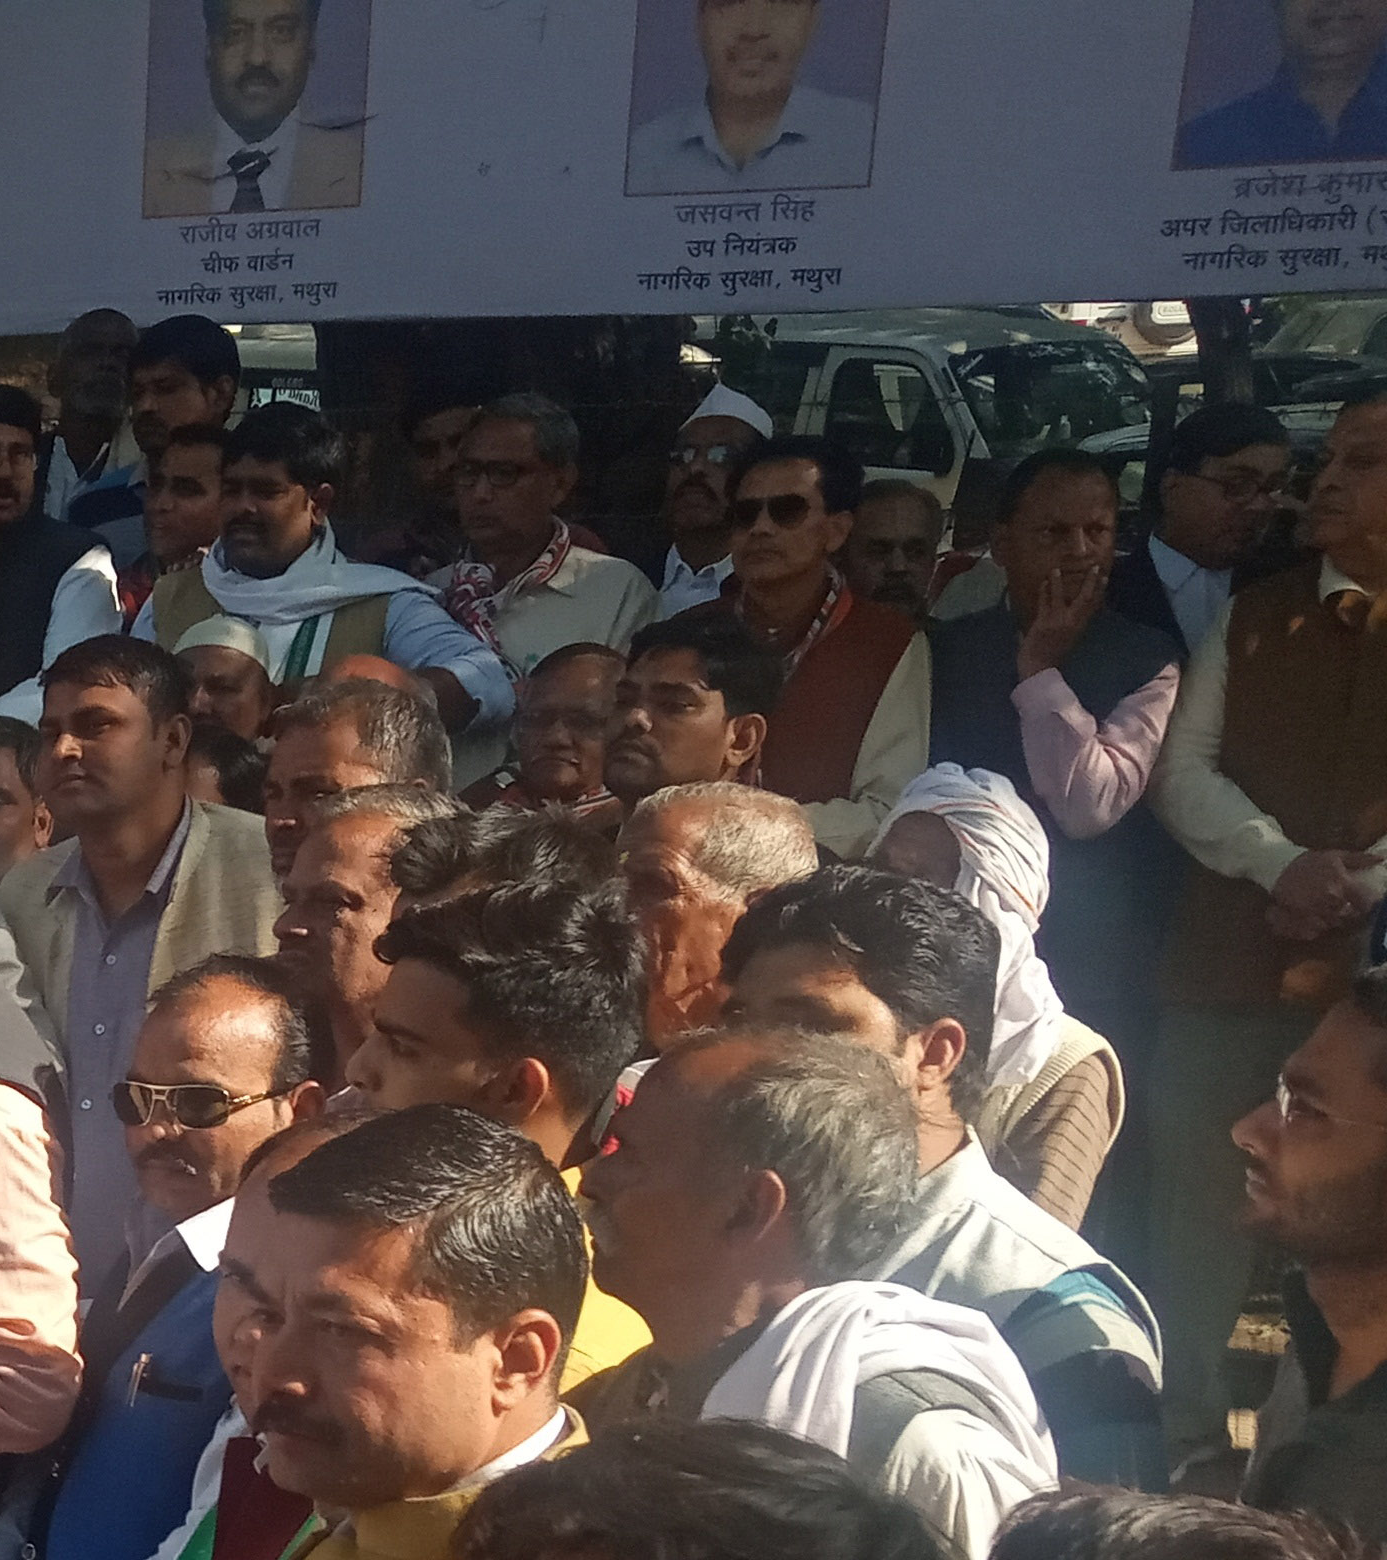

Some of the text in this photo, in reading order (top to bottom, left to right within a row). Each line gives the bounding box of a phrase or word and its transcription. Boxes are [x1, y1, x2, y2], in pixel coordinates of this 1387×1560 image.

[674, 194, 816, 224] जसवन्त सिंह
[1160, 217, 1212, 237] अपर
[1220, 204, 1358, 235] जिलाधिकारी
[179, 216, 321, 244] राजीव अग्रवाल
[686, 232, 798, 258] उप नियंत्रक
[1182, 243, 1269, 271] नागरिक
[201, 248, 295, 274] चीफ वार्डन
[636, 266, 712, 290] नागरिक
[790, 267, 843, 293] मथुरा
[156, 282, 222, 306] नागरिक
[291, 281, 338, 306] मथुरा
